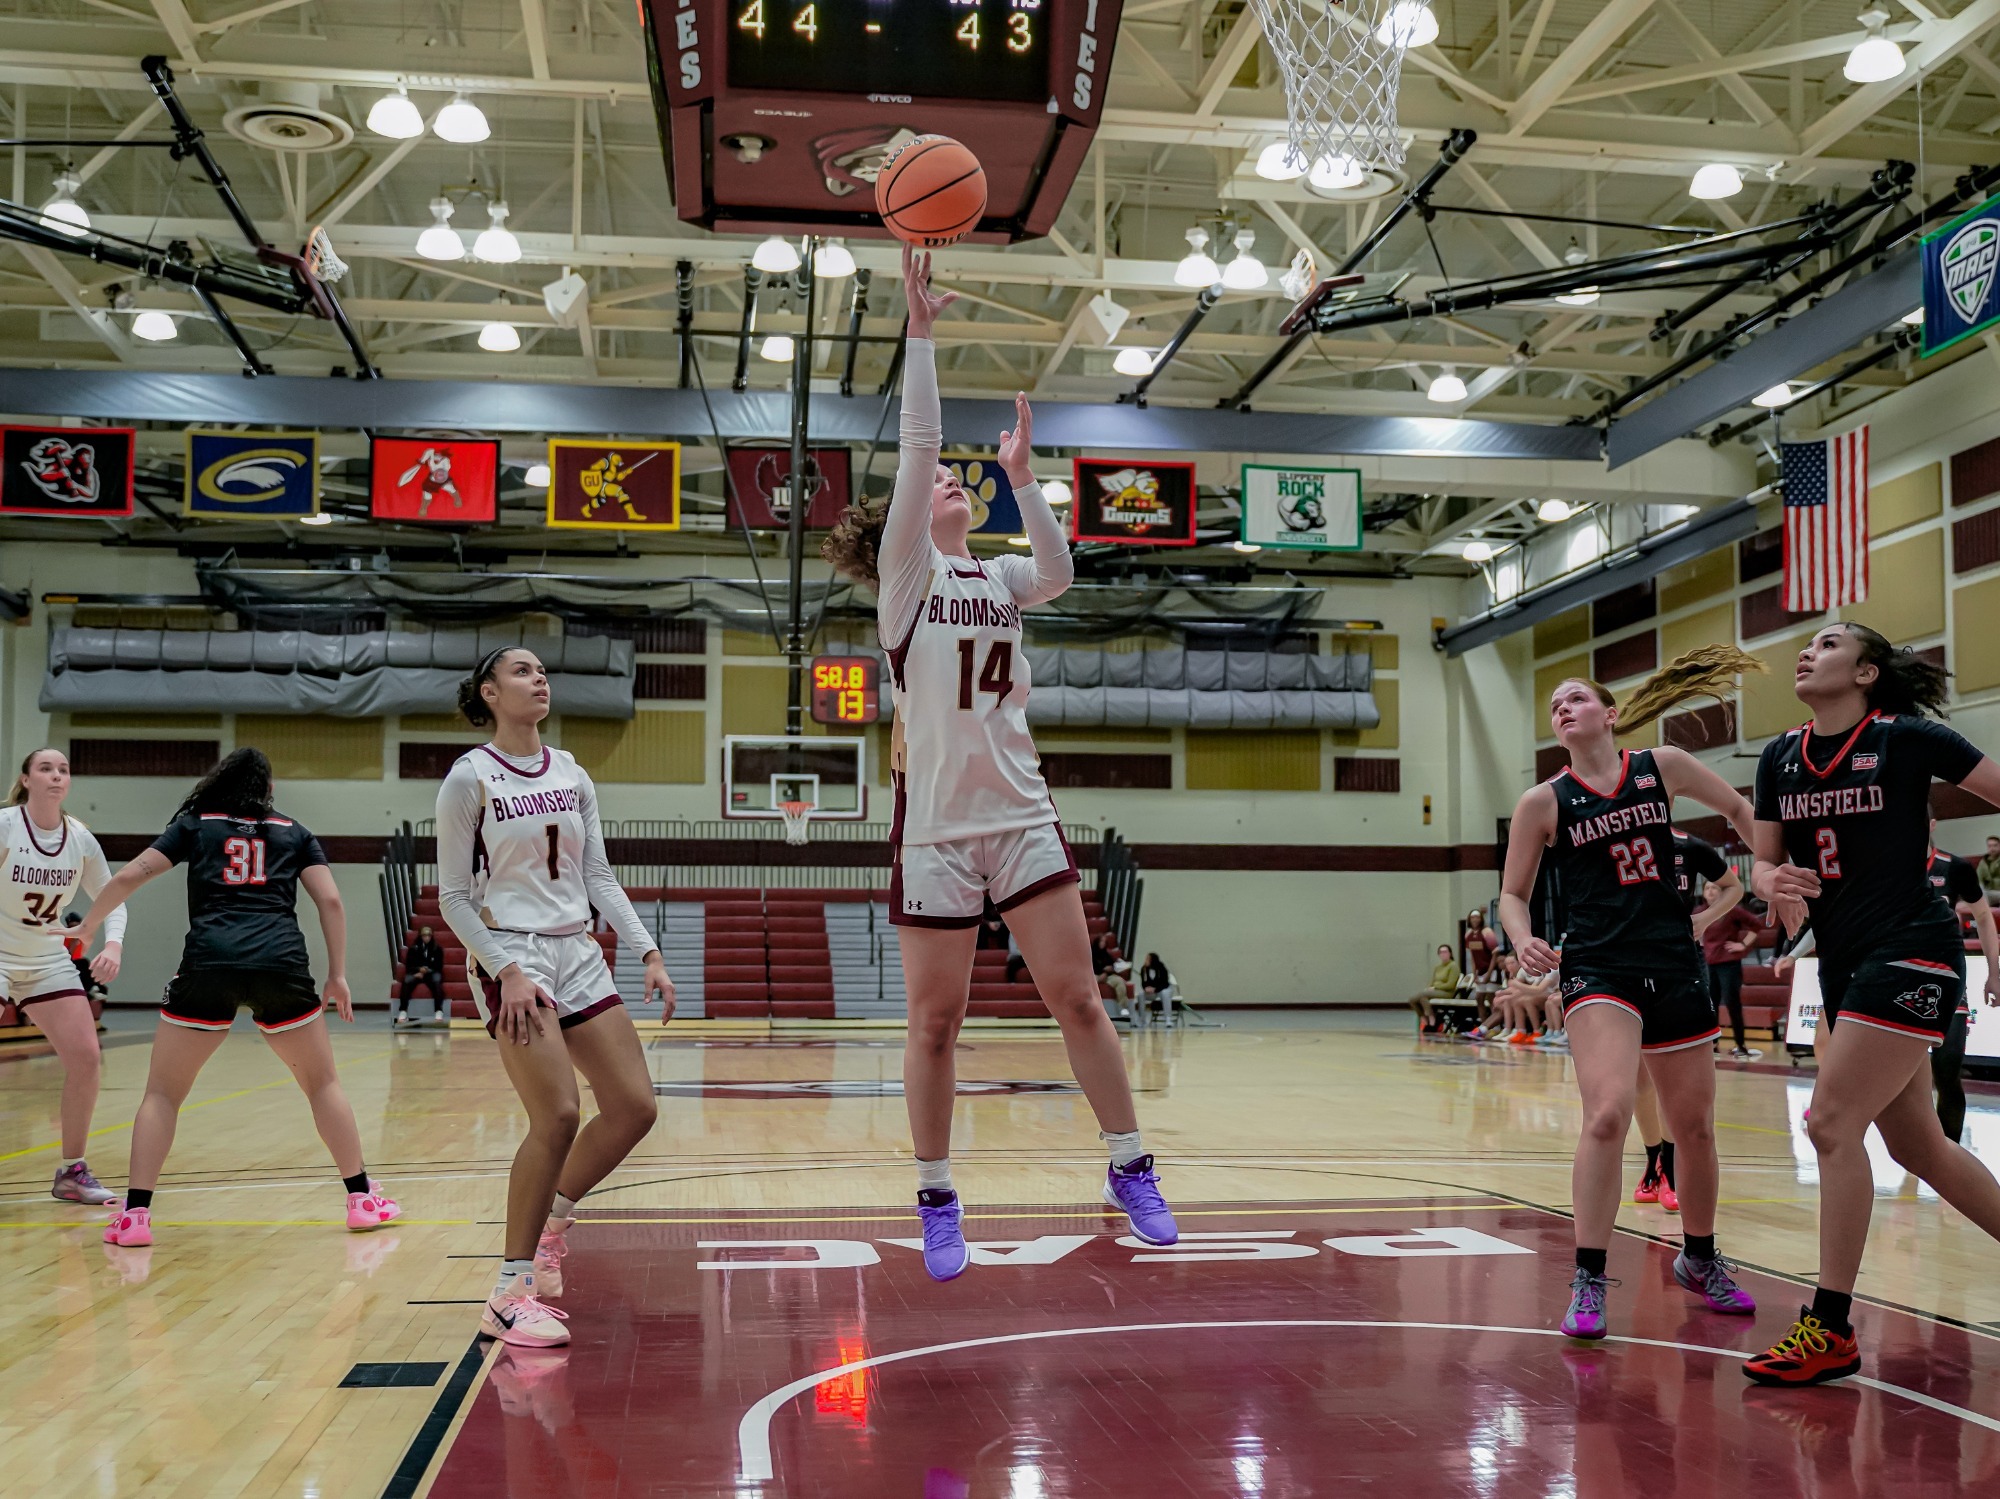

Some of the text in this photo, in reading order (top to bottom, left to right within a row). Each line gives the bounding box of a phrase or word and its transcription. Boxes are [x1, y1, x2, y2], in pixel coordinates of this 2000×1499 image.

[675, 0, 702, 90] ES
[1950, 244, 1995, 289] MAC
[584, 474, 600, 487] GU
[1277, 480, 1325, 497] ROCK
[814, 665, 865, 690] 58.8
[957, 637, 1016, 711] 14
[838, 690, 865, 721] 13
[1568, 802, 1668, 847] MANSFIELD
[223, 837, 267, 885] 31
[545, 823, 561, 881] 1
[1609, 836, 1660, 885] 22
[1816, 827, 1842, 879] 2
[22, 892, 64, 926] 34
